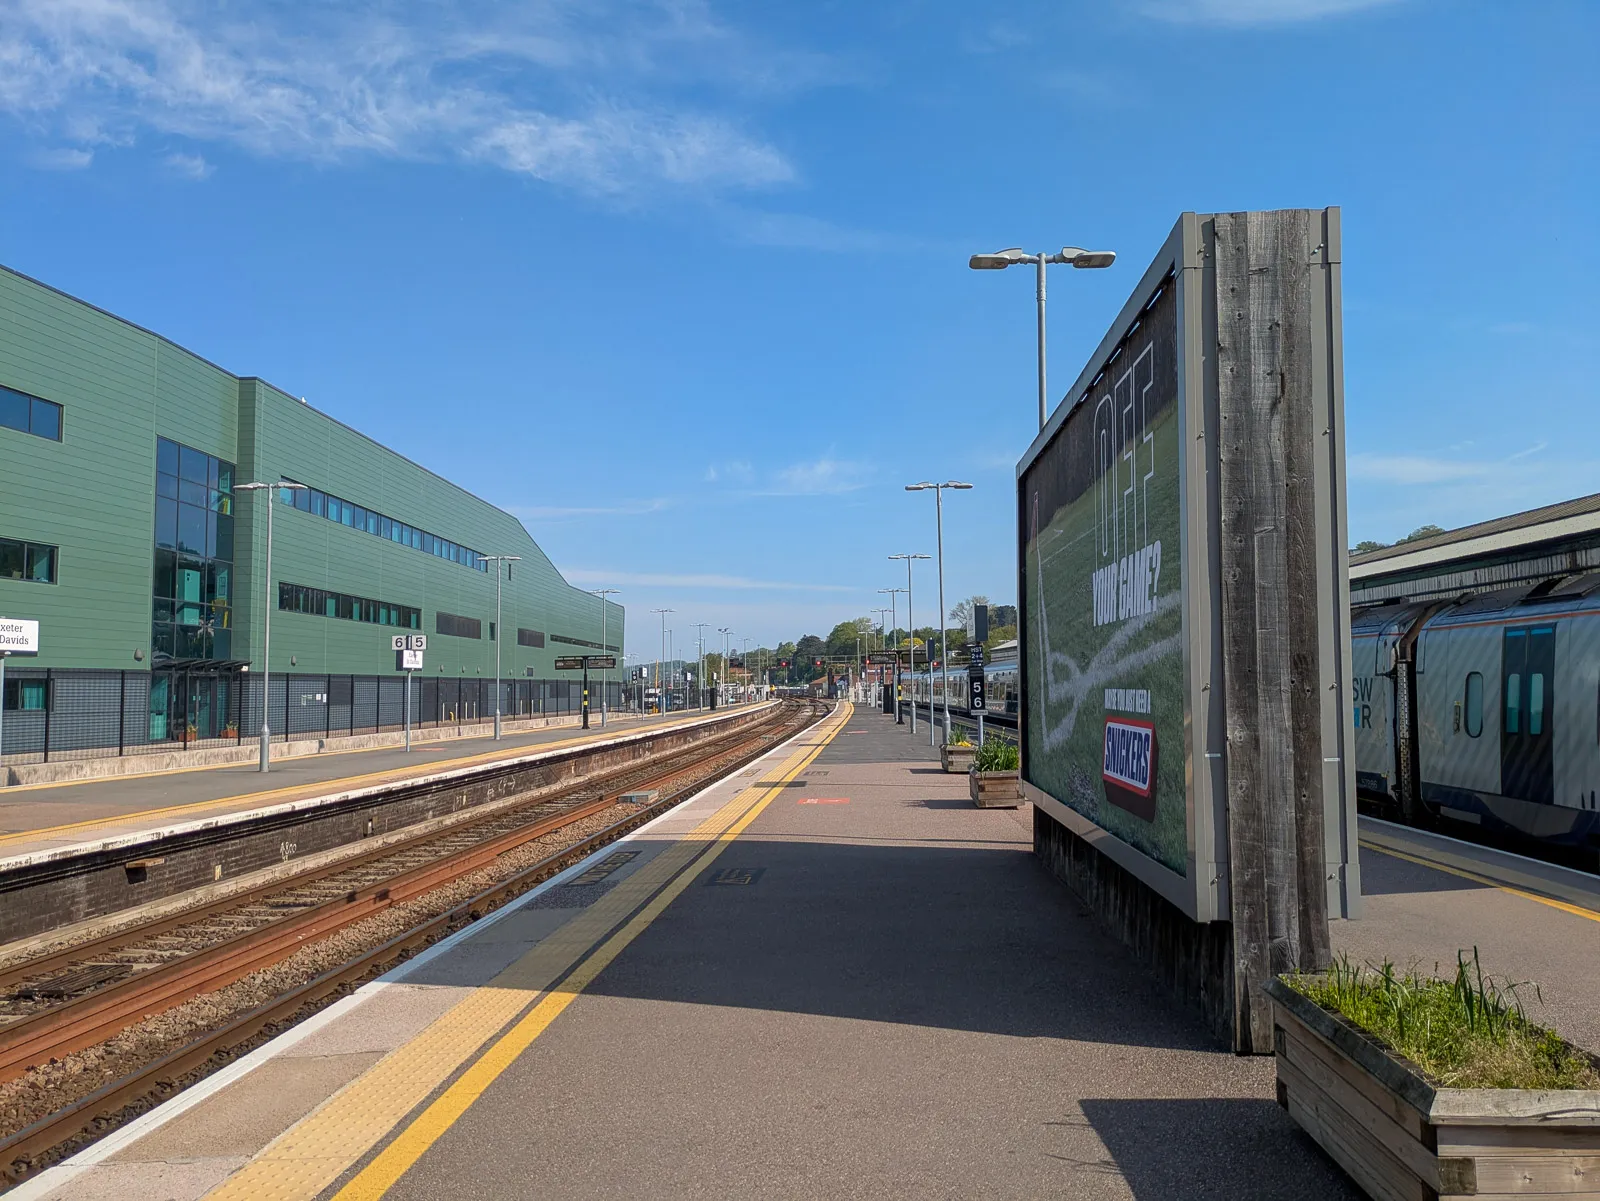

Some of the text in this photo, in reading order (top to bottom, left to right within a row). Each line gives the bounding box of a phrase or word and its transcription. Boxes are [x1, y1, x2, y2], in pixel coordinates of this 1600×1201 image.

[1093, 540, 1162, 626] YOUR GAME?
[395, 637, 403, 648] 6
[415, 637, 423, 648] 5
[973, 682, 982, 693] 5
[974, 697, 983, 708] 6
[1362, 704, 1371, 729] R
[1105, 726, 1150, 785] SNICKERS
